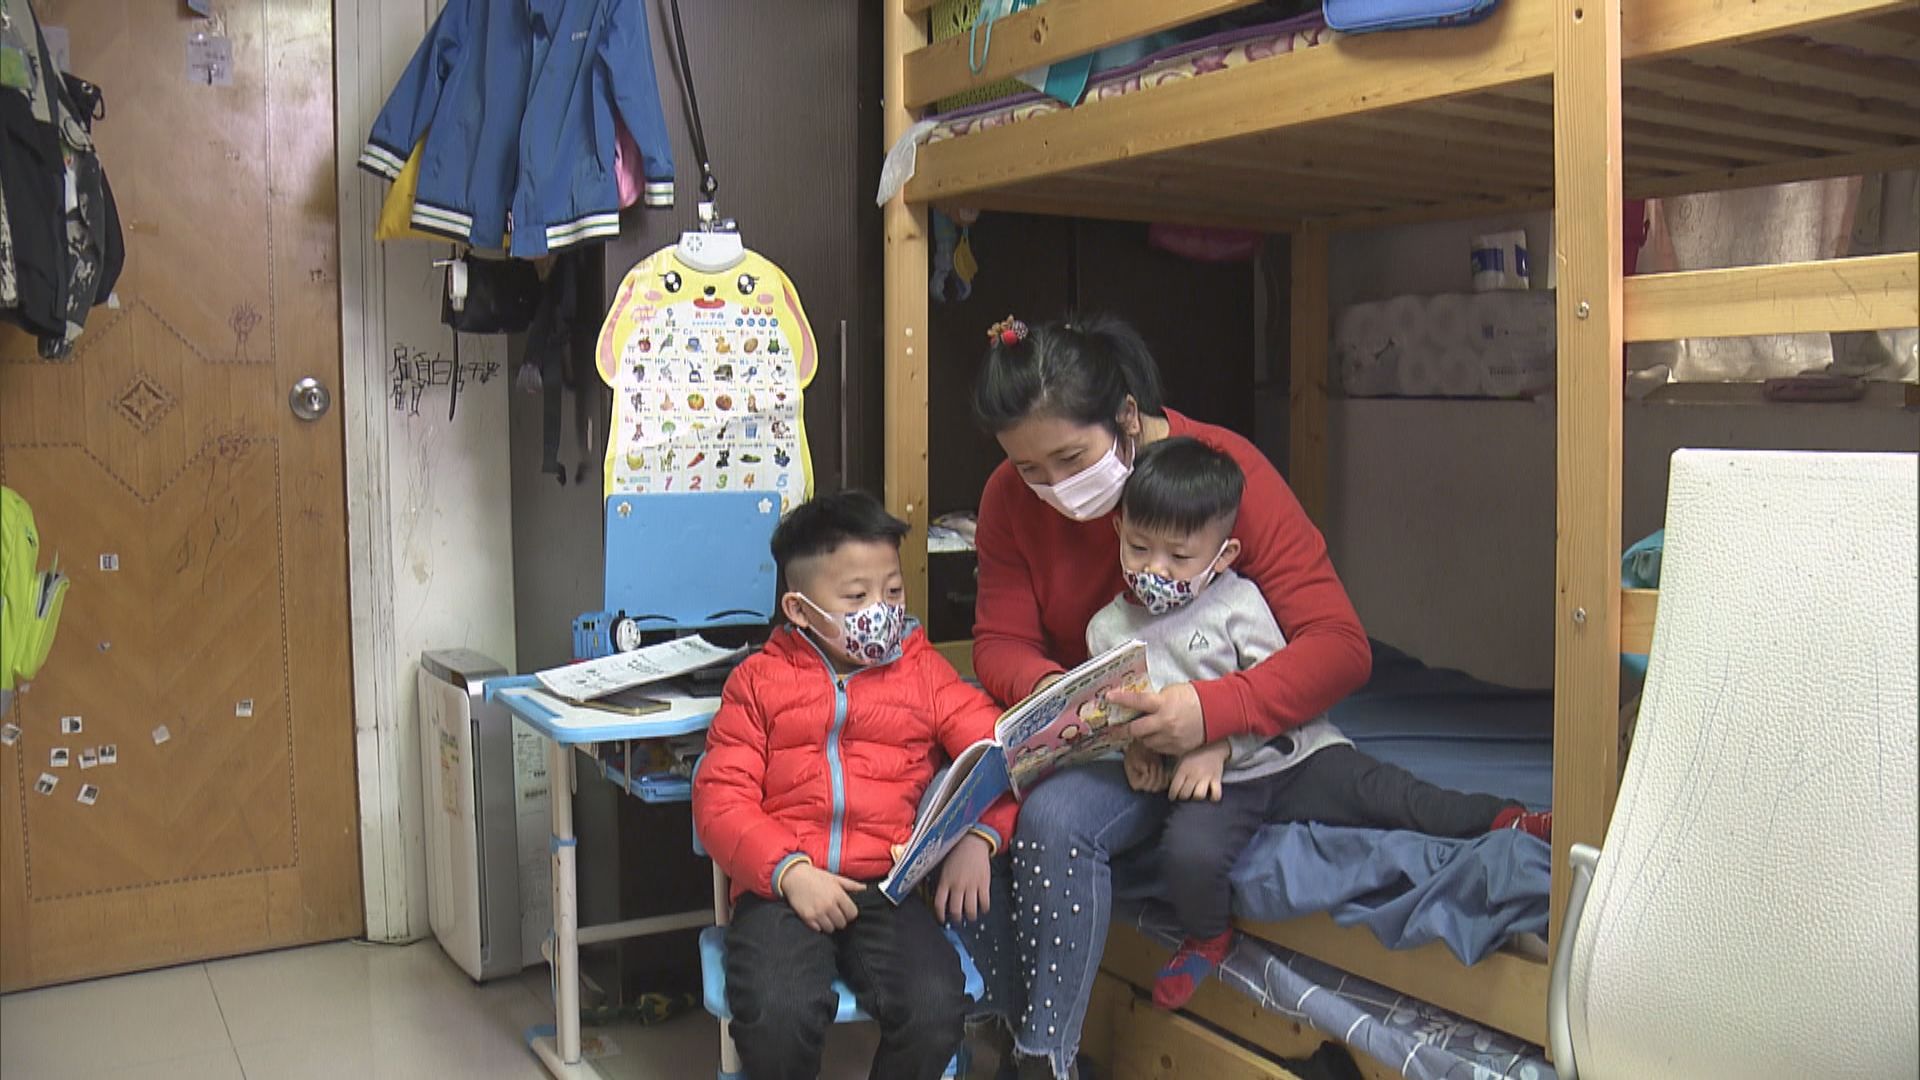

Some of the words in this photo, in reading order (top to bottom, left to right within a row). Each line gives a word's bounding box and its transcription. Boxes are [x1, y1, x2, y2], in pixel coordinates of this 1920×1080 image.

[664, 476, 673, 491] 1
[689, 475, 702, 491] 2
[716, 473, 728, 489] 3
[743, 472, 755, 488] 4
[776, 473, 789, 487] 5
